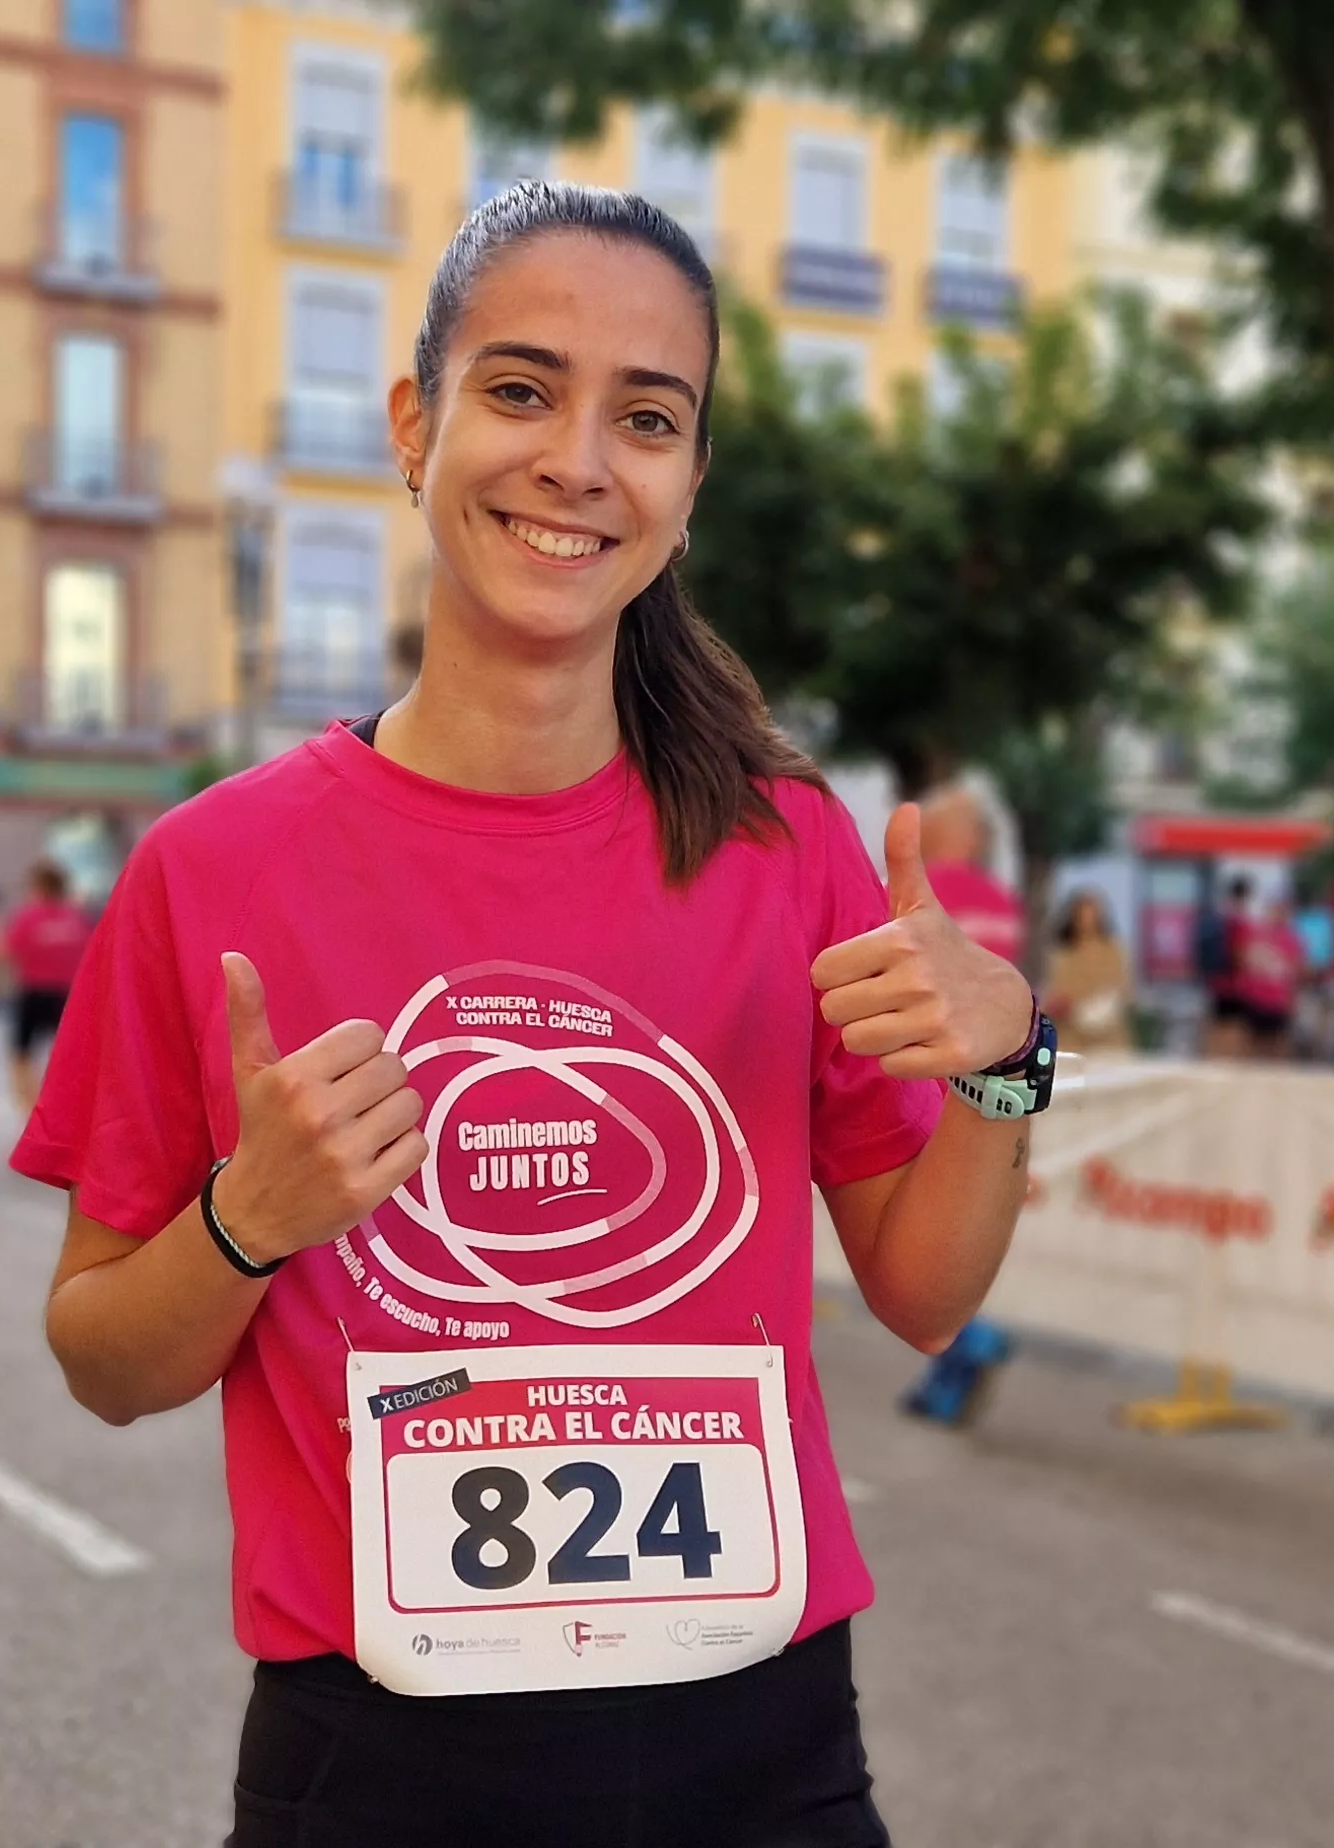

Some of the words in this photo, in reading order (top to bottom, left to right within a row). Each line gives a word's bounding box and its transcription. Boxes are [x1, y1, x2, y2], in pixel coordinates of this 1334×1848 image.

[446, 996, 458, 1009] X
[460, 996, 538, 1010] CARRERA
[548, 999, 612, 1023] HUESCA
[456, 1012, 523, 1025] CONTRA
[525, 1013, 545, 1027] EL
[548, 1014, 614, 1037] CÁNCER
[458, 1118, 597, 1151] Caminemos
[469, 1151, 589, 1191] JUNTOS
[363, 1276, 384, 1301] Te
[379, 1293, 441, 1337] escucho,
[444, 1316, 461, 1337] Te
[463, 1320, 510, 1341] apoyo
[380, 1397, 395, 1413] X
[393, 1377, 459, 1410] EDICIÓN
[528, 1384, 627, 1407] HUESCA
[403, 1412, 556, 1448] CONTRA
[565, 1411, 604, 1441] EL
[611, 1405, 744, 1440] CÁNCER
[450, 1461, 723, 1590] 824
